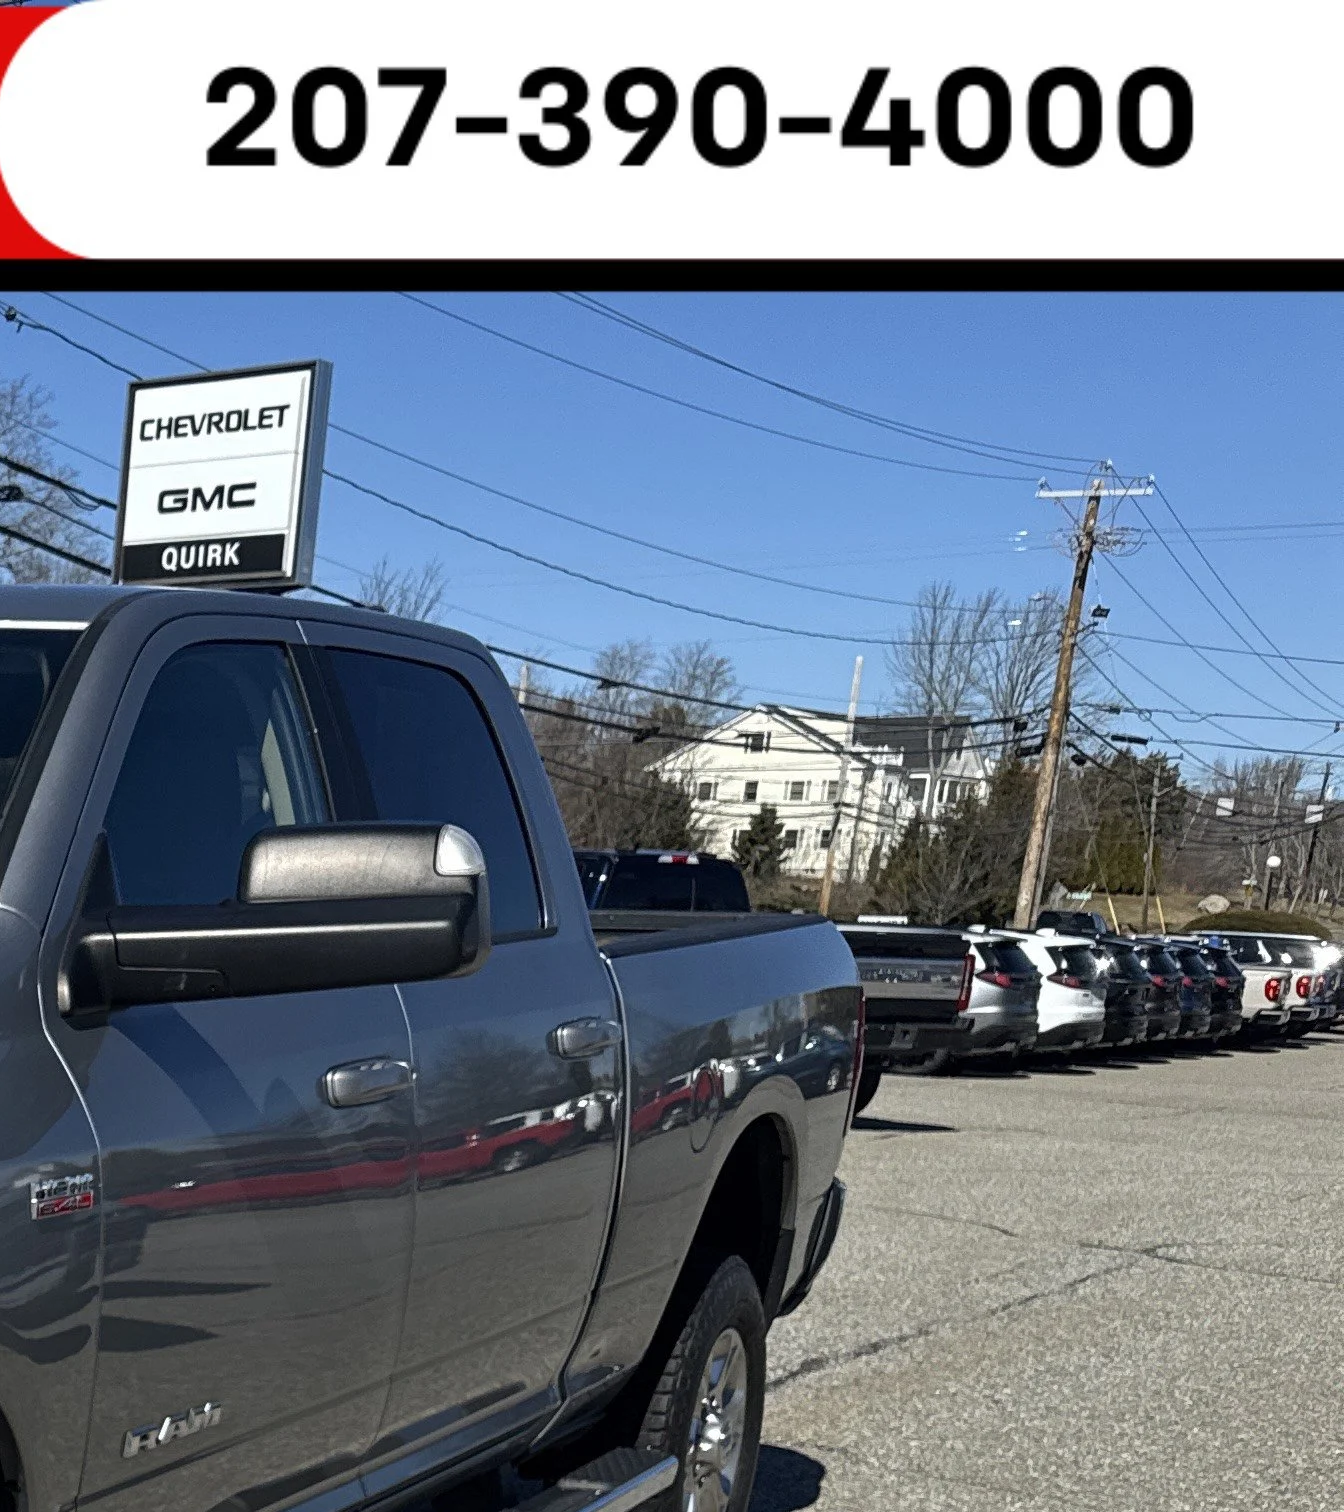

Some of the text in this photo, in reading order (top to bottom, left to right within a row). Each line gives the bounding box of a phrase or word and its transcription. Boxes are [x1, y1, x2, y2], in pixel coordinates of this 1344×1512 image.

[139, 404, 291, 442] CHEVROLET
[157, 482, 257, 514] GMC
[161, 541, 241, 572] QUIRK
[122, 1401, 222, 1459] RAM
